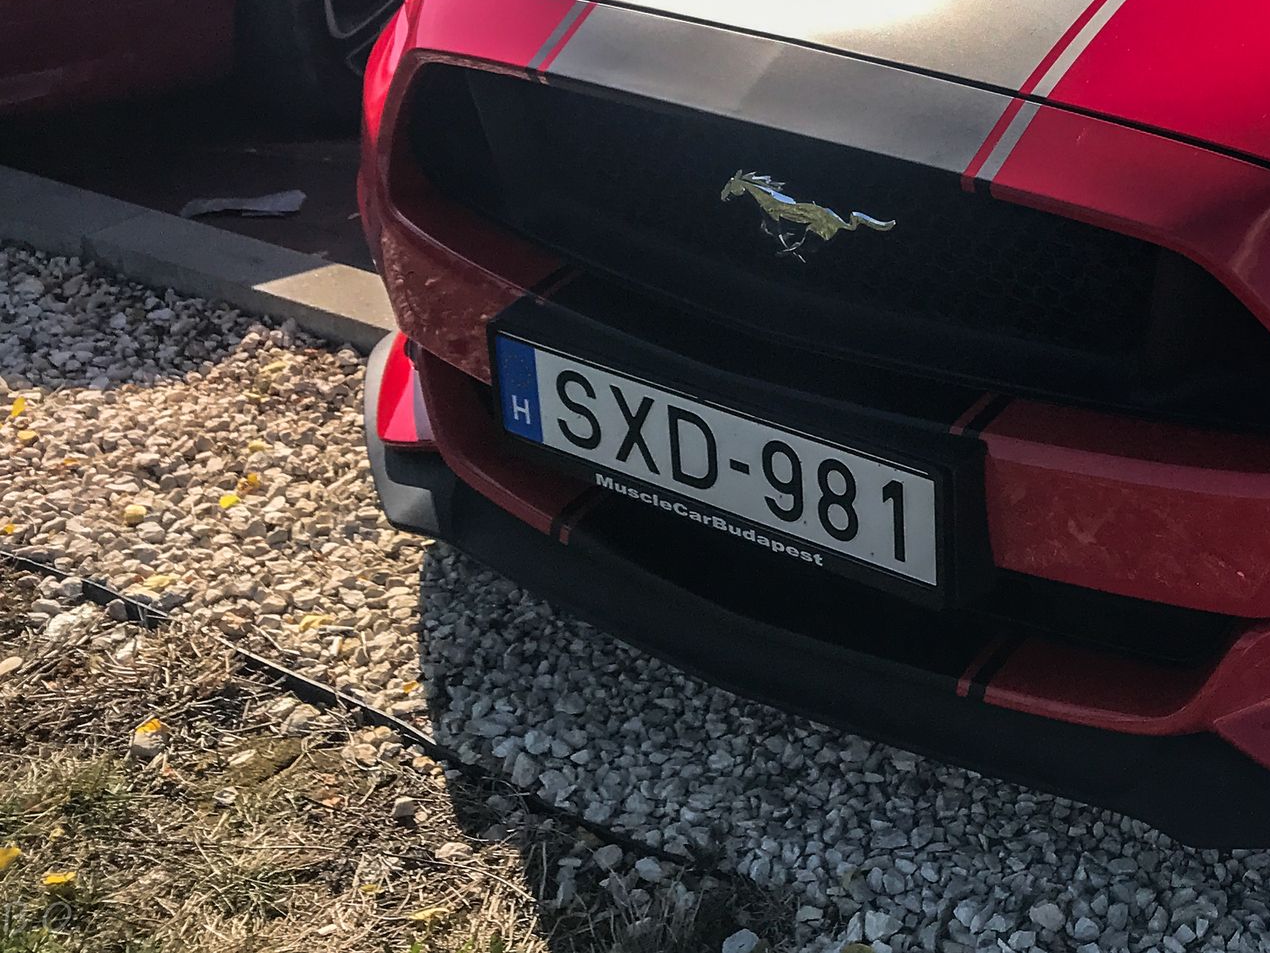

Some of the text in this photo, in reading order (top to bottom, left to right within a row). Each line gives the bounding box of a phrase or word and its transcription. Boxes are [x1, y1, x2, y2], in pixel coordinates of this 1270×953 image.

[512, 395, 531, 425] H
[556, 370, 906, 563] SXD-981
[595, 473, 824, 567] MuscleCarBudapest
